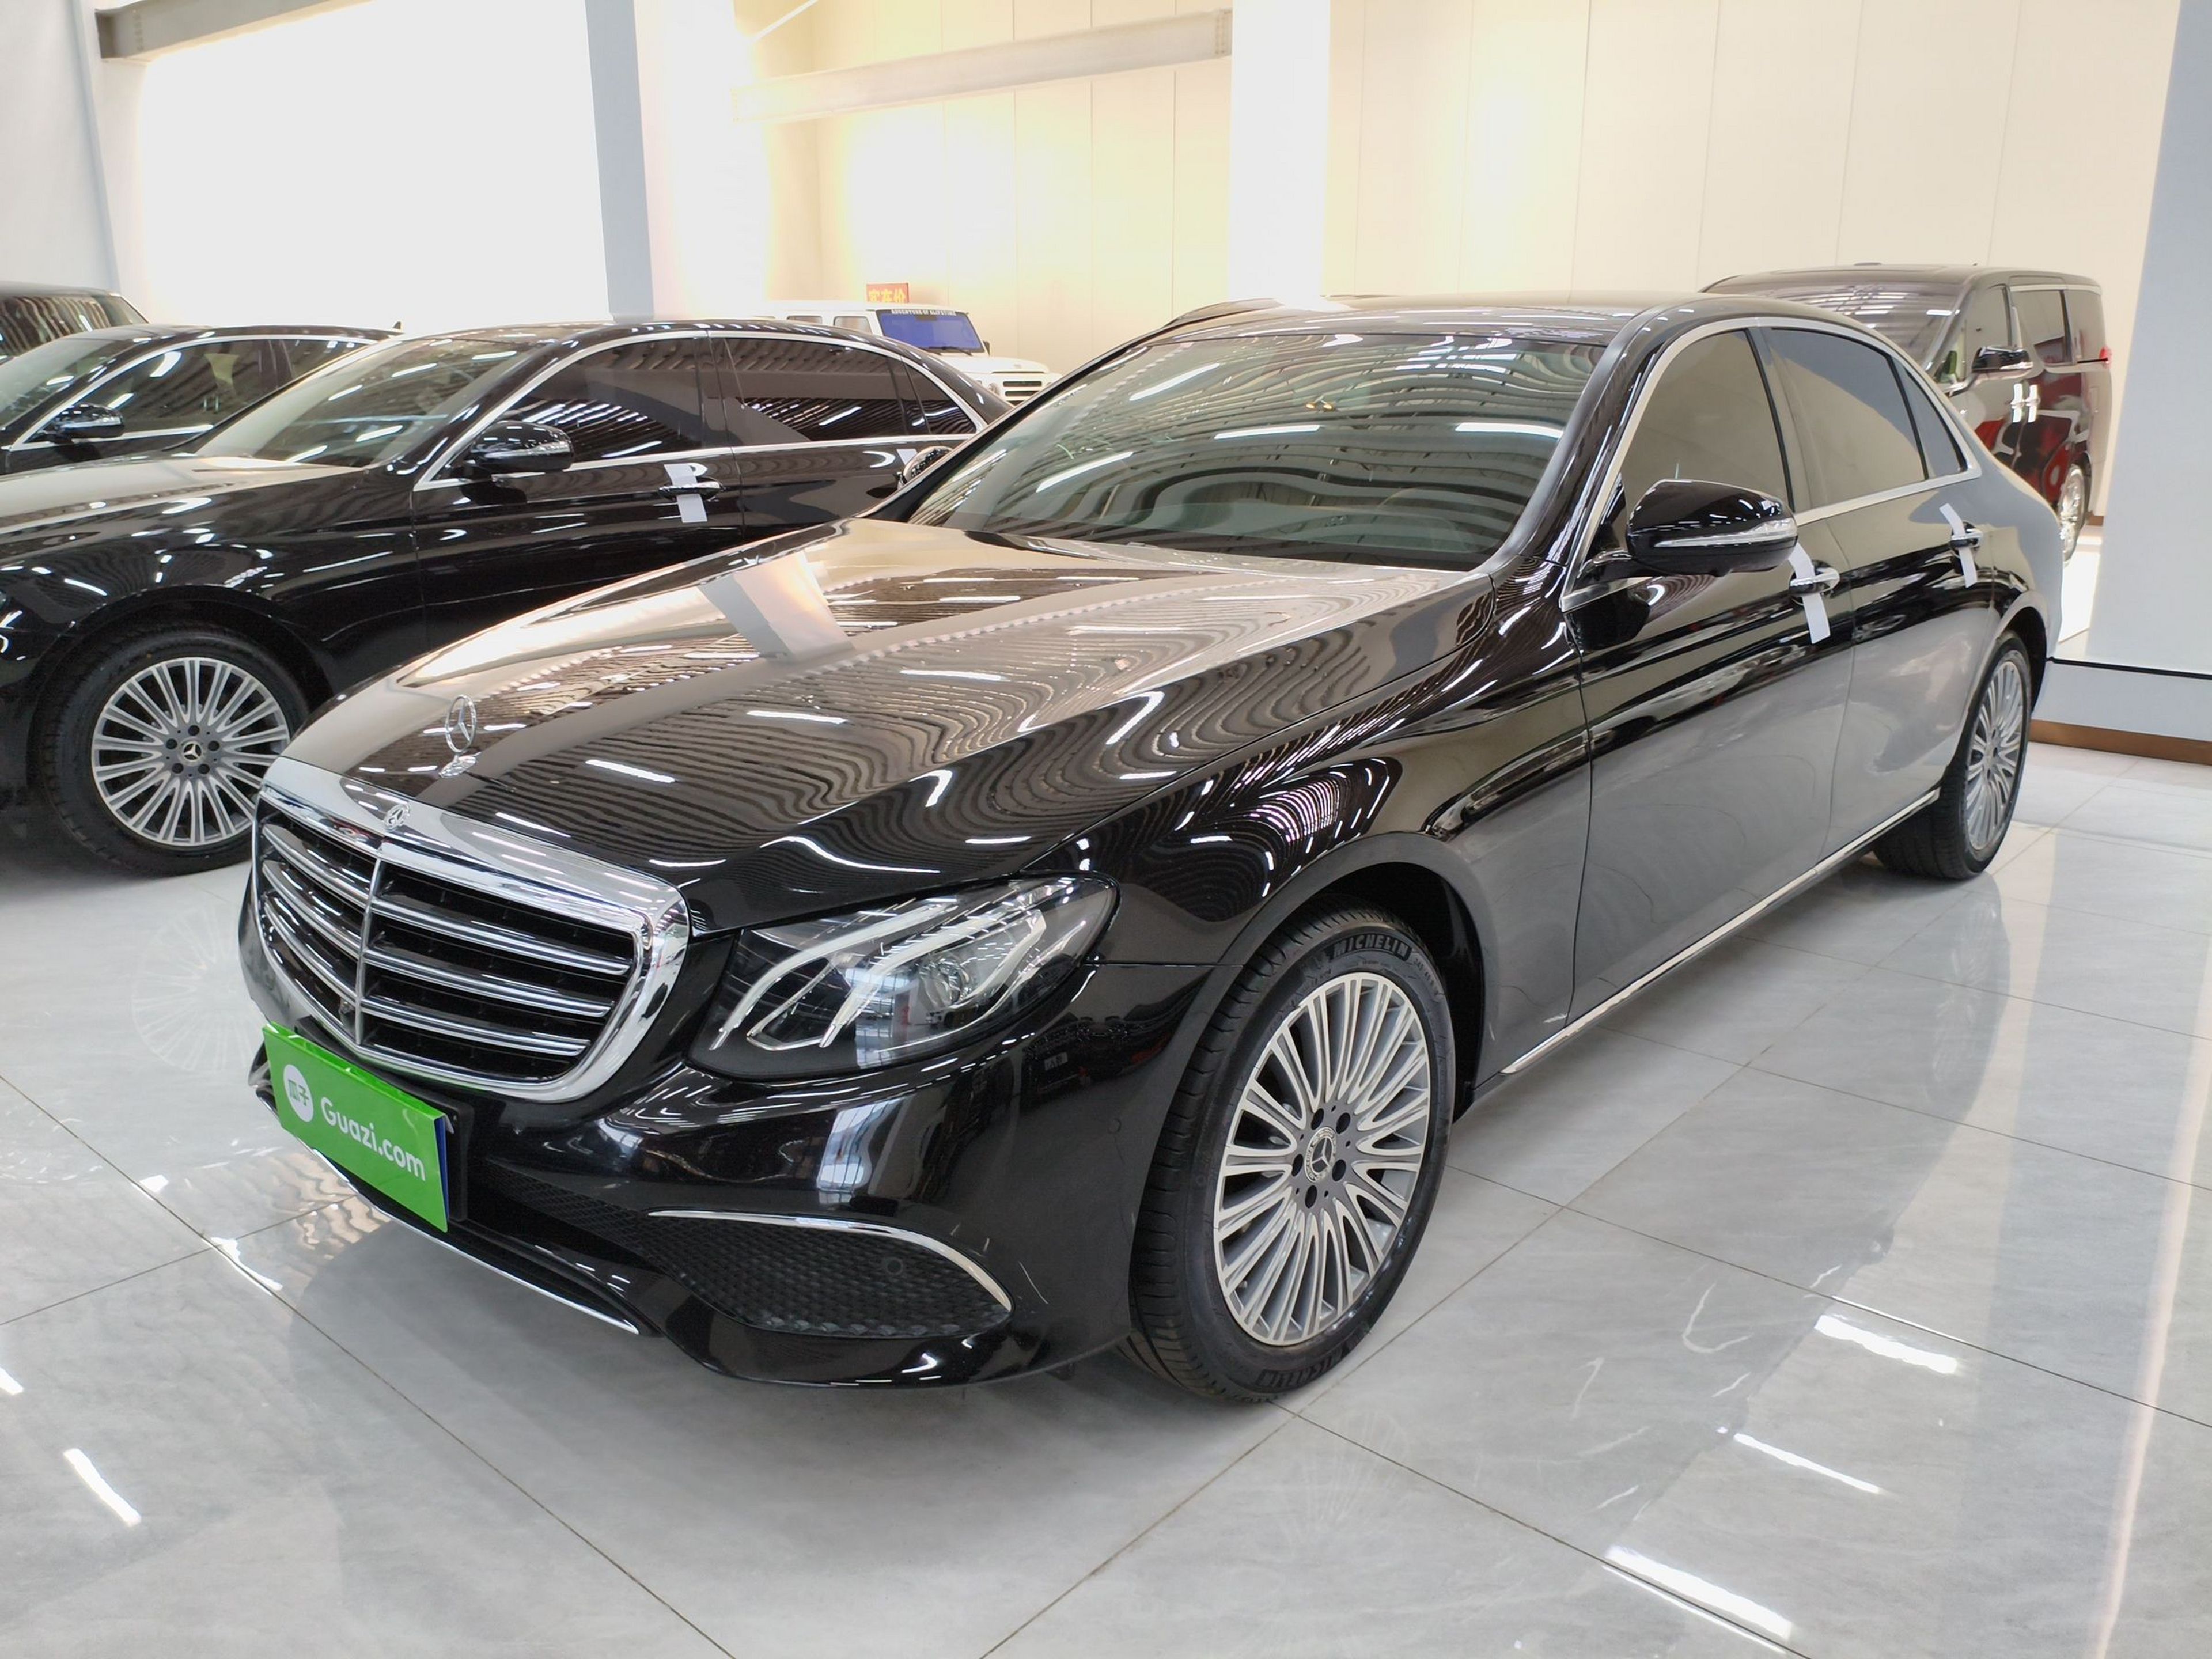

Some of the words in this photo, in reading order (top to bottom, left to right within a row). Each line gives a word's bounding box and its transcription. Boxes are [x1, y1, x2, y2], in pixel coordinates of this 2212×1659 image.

[1334, 934, 1409, 958] MICHELIN
[287, 1079, 310, 1107] 瓜子
[321, 1097, 426, 1181] Guazi.com
